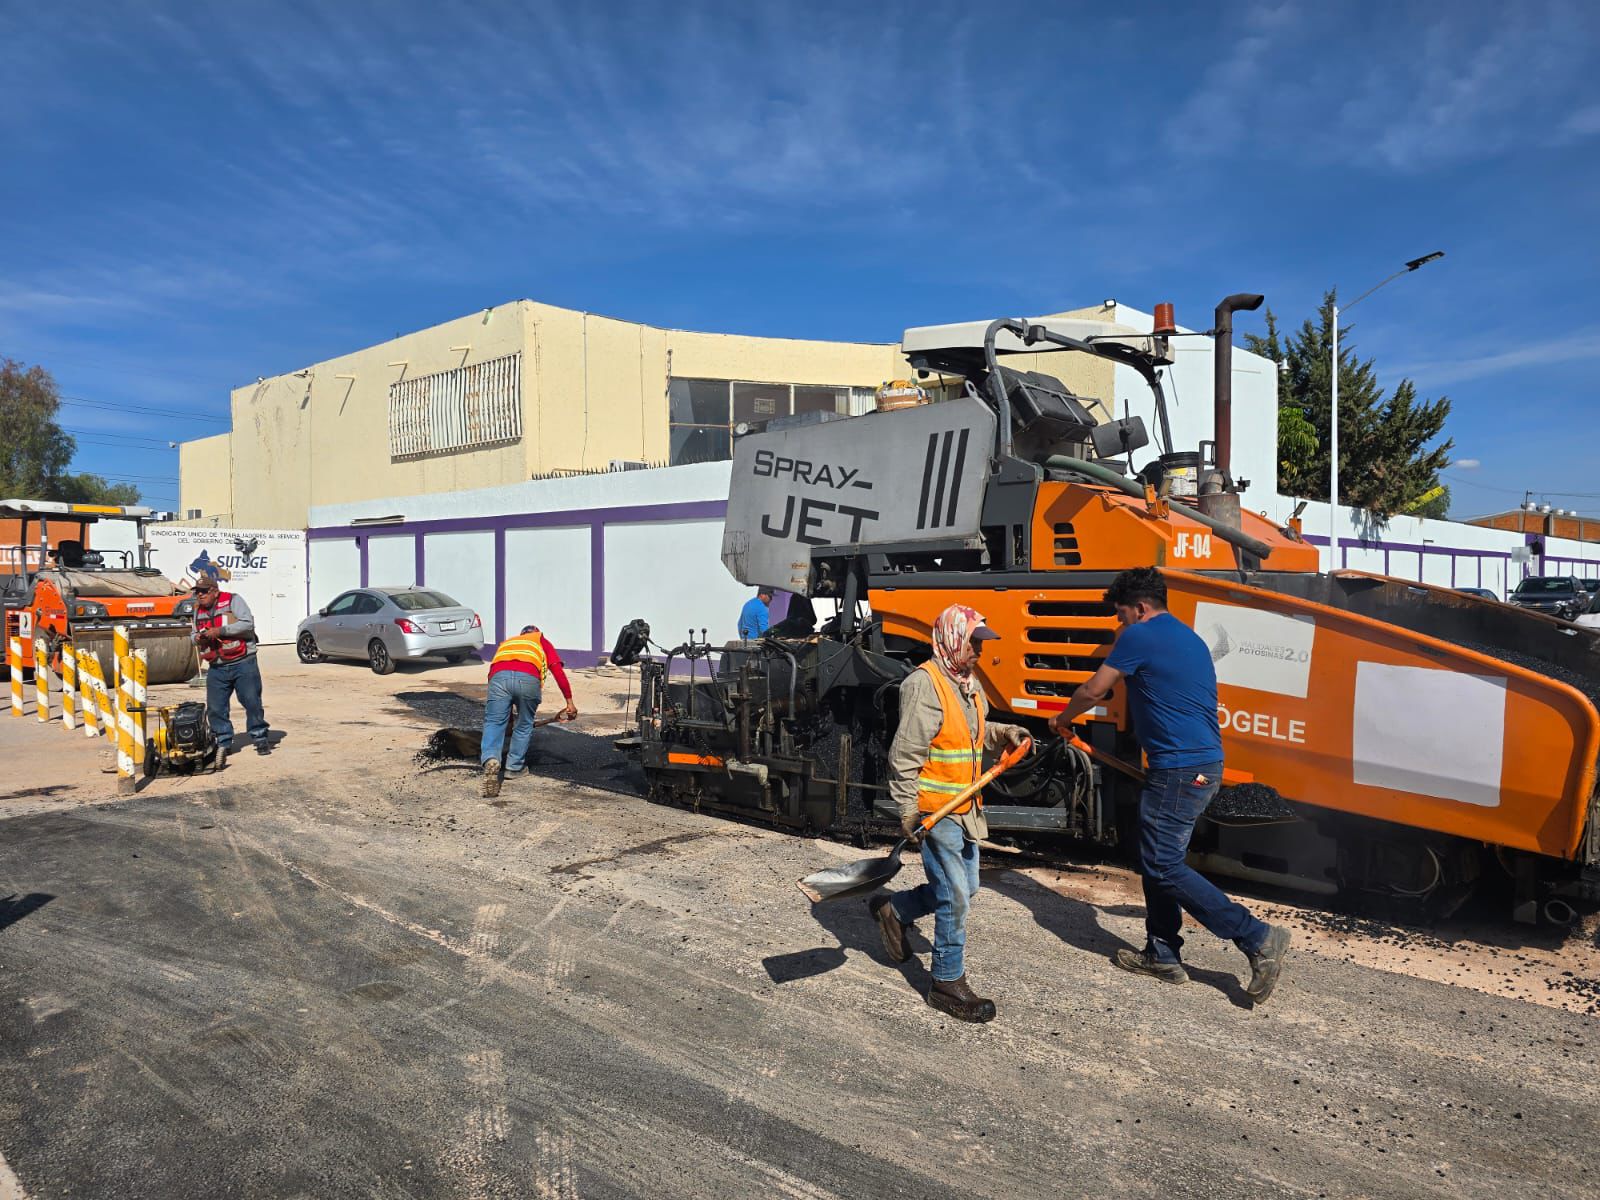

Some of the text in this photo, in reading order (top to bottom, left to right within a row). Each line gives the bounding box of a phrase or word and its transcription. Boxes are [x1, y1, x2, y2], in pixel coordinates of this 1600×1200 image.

[753, 449, 873, 490] SPRAY-
[761, 495, 880, 546] JET
[217, 555, 268, 569] SUTSGE
[1173, 532, 1212, 559] JF-04
[1239, 646, 1309, 663] POTOSINAS 2.0
[1217, 702, 1306, 744] ÖGELE
